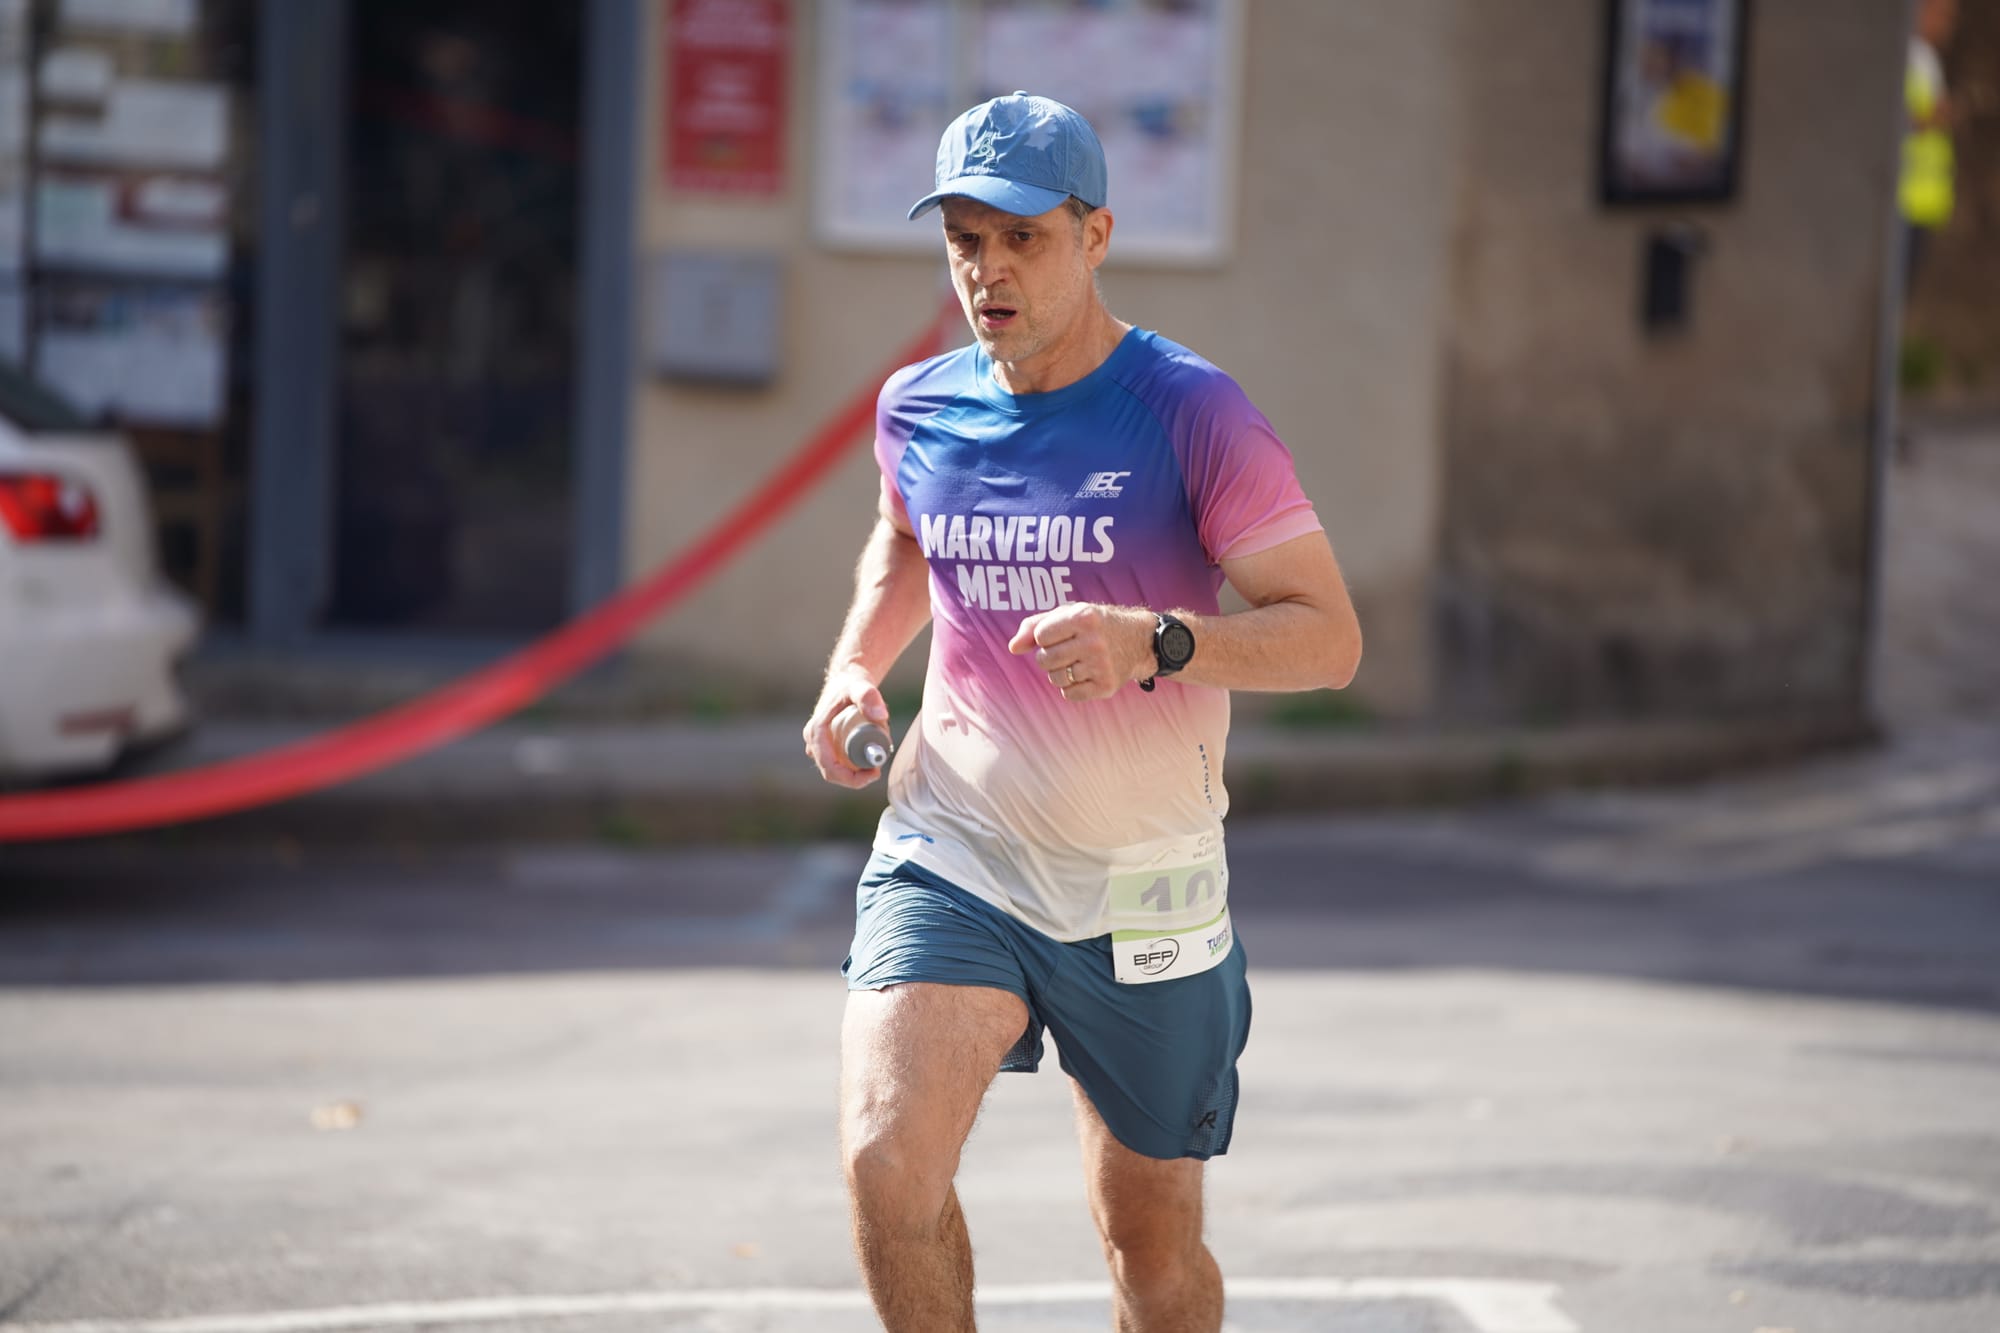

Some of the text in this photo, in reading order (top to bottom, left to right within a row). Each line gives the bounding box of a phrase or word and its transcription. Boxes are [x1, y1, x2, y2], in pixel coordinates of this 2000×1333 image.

[920, 514, 1115, 562] MARVEJOLS
[956, 564, 1074, 611] MENDE
[1134, 950, 1173, 966] BFP
